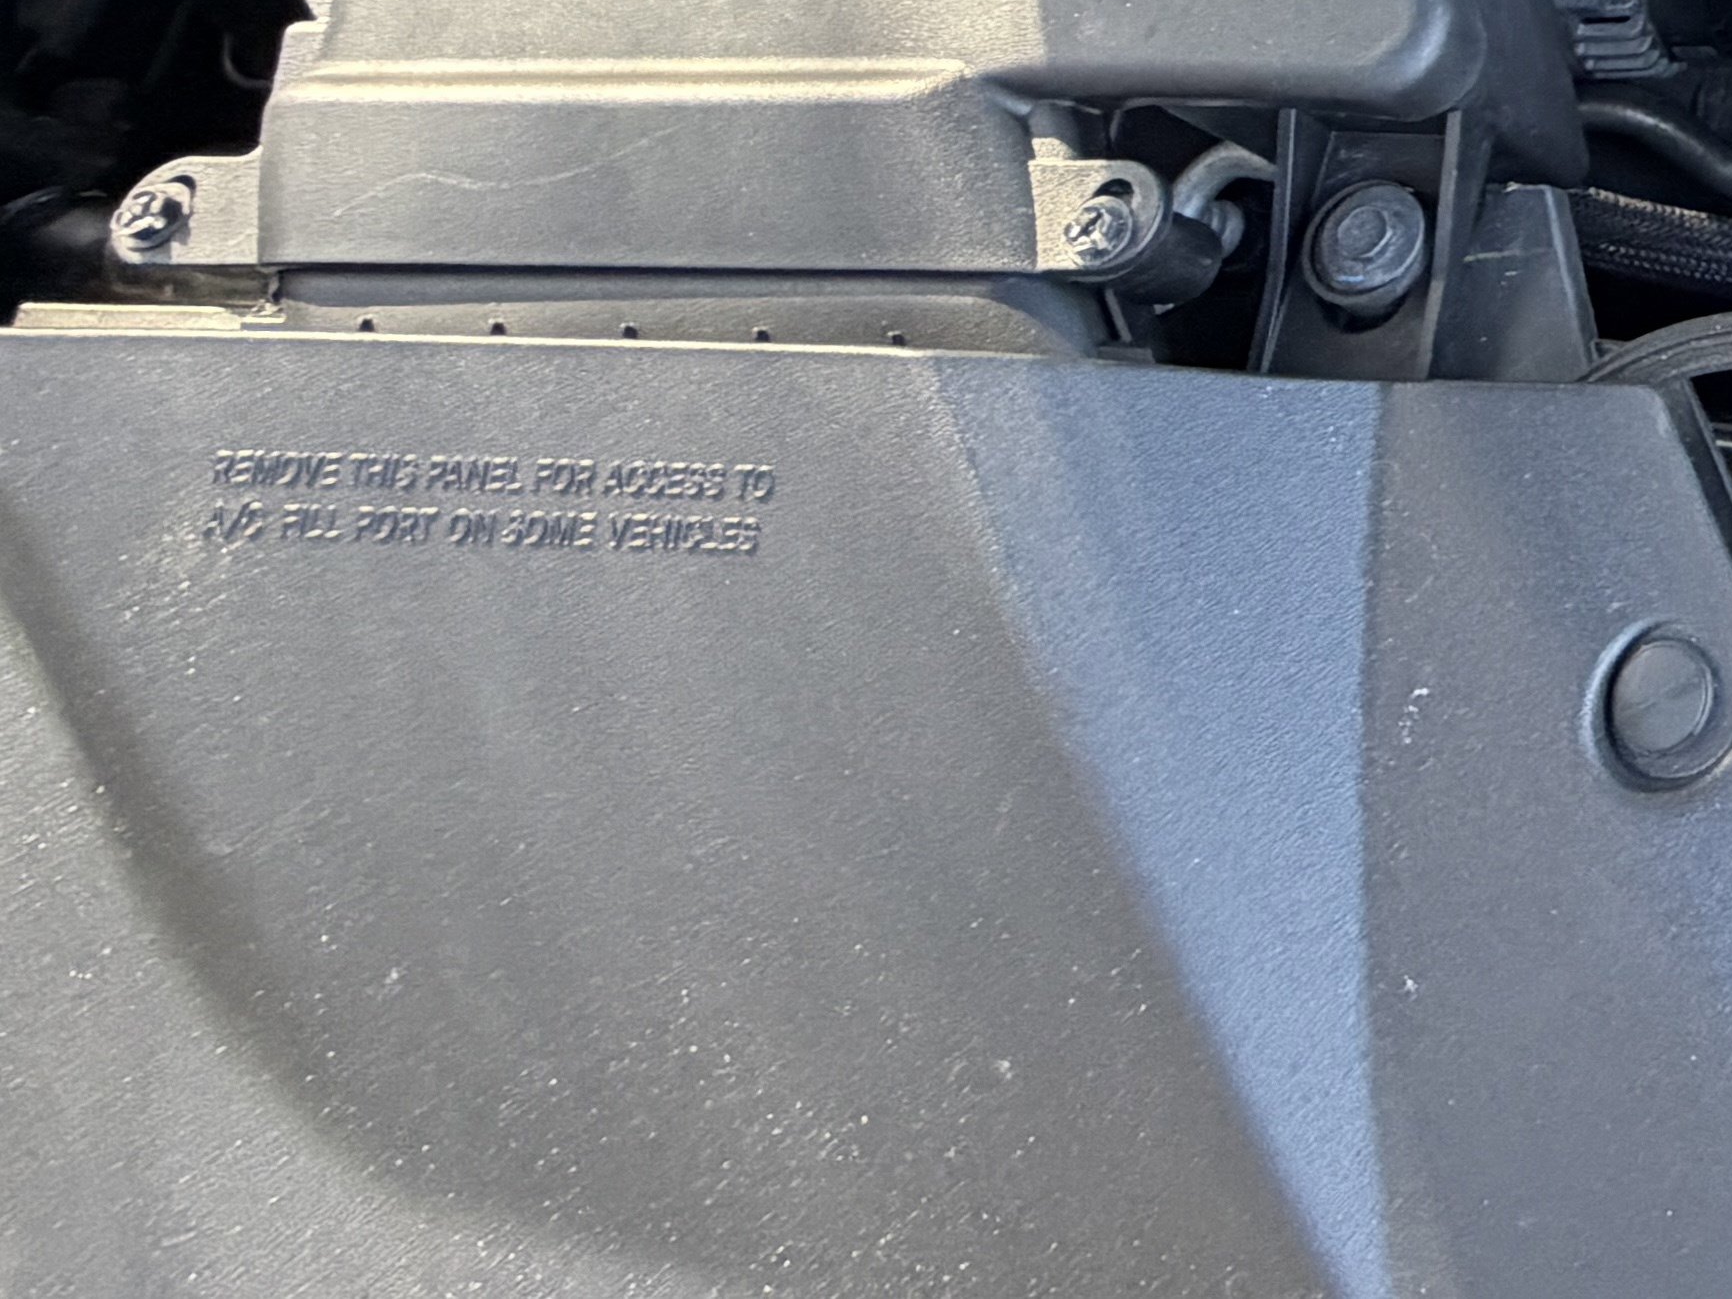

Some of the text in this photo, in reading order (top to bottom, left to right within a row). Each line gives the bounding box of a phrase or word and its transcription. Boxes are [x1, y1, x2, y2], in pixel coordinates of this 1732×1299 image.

[211, 448, 777, 499] REMOVE THIS PANEL FOR ACCESS TO
[203, 498, 762, 553] A/C FILL PORT ON SOME VEHICLES
